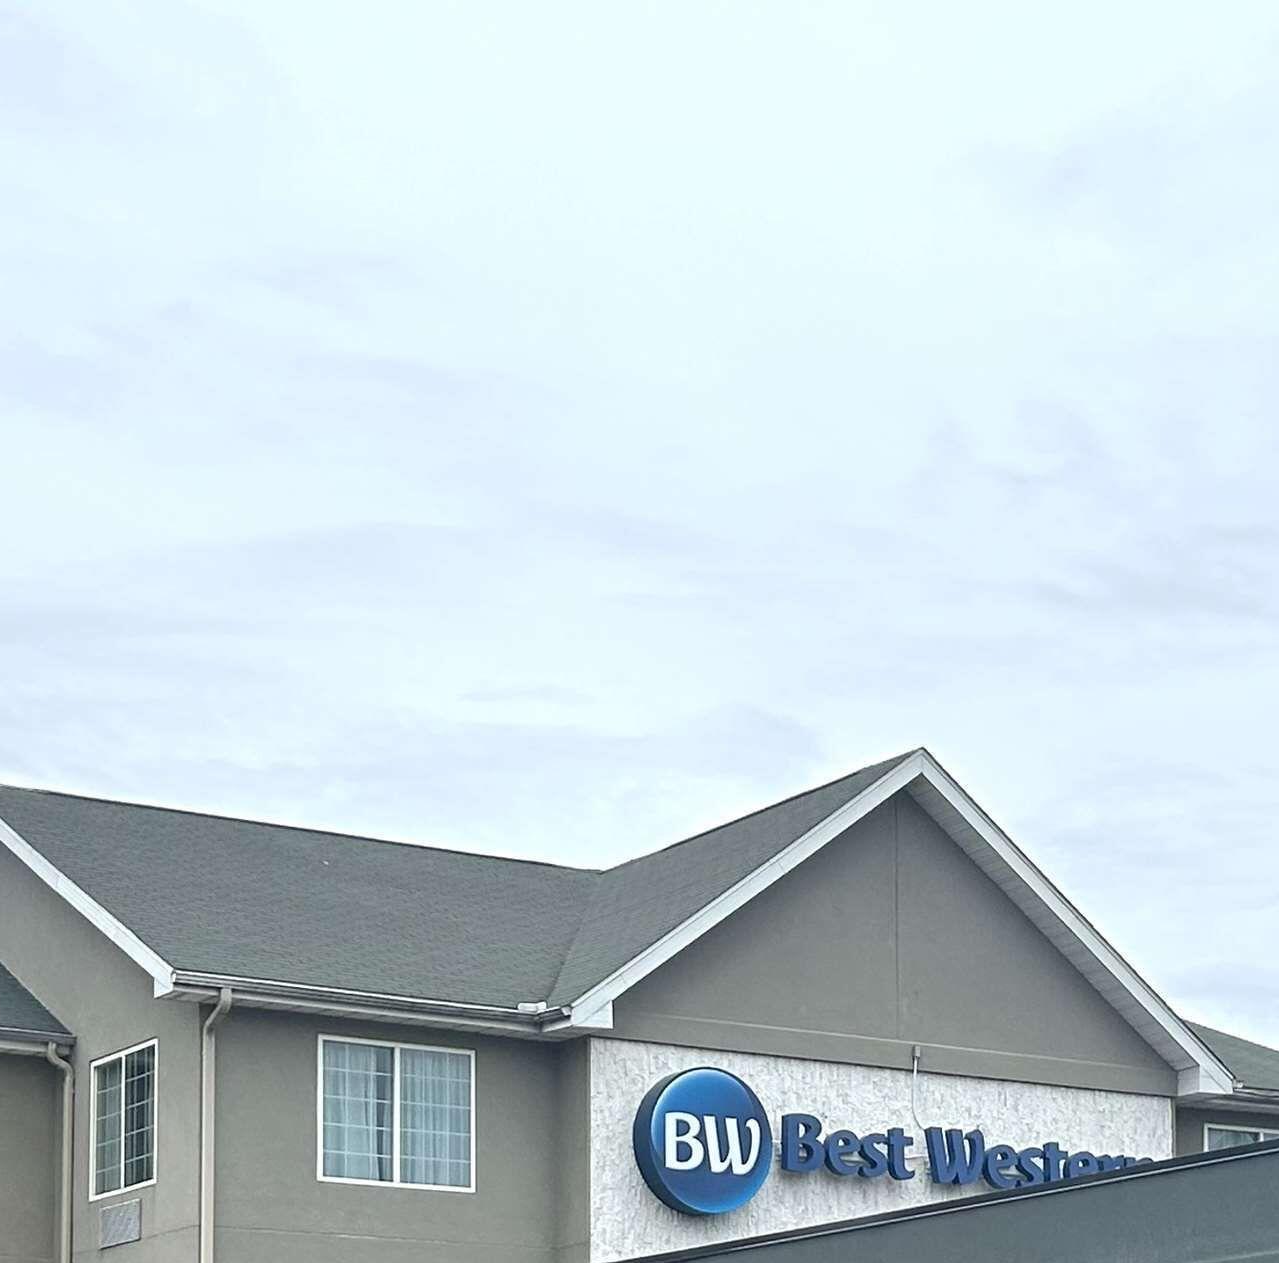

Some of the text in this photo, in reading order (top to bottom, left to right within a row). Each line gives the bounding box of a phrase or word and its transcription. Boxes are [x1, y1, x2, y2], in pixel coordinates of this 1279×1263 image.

[664, 1111, 761, 1176] BW
[781, 1113, 1154, 1189] Best Weste
